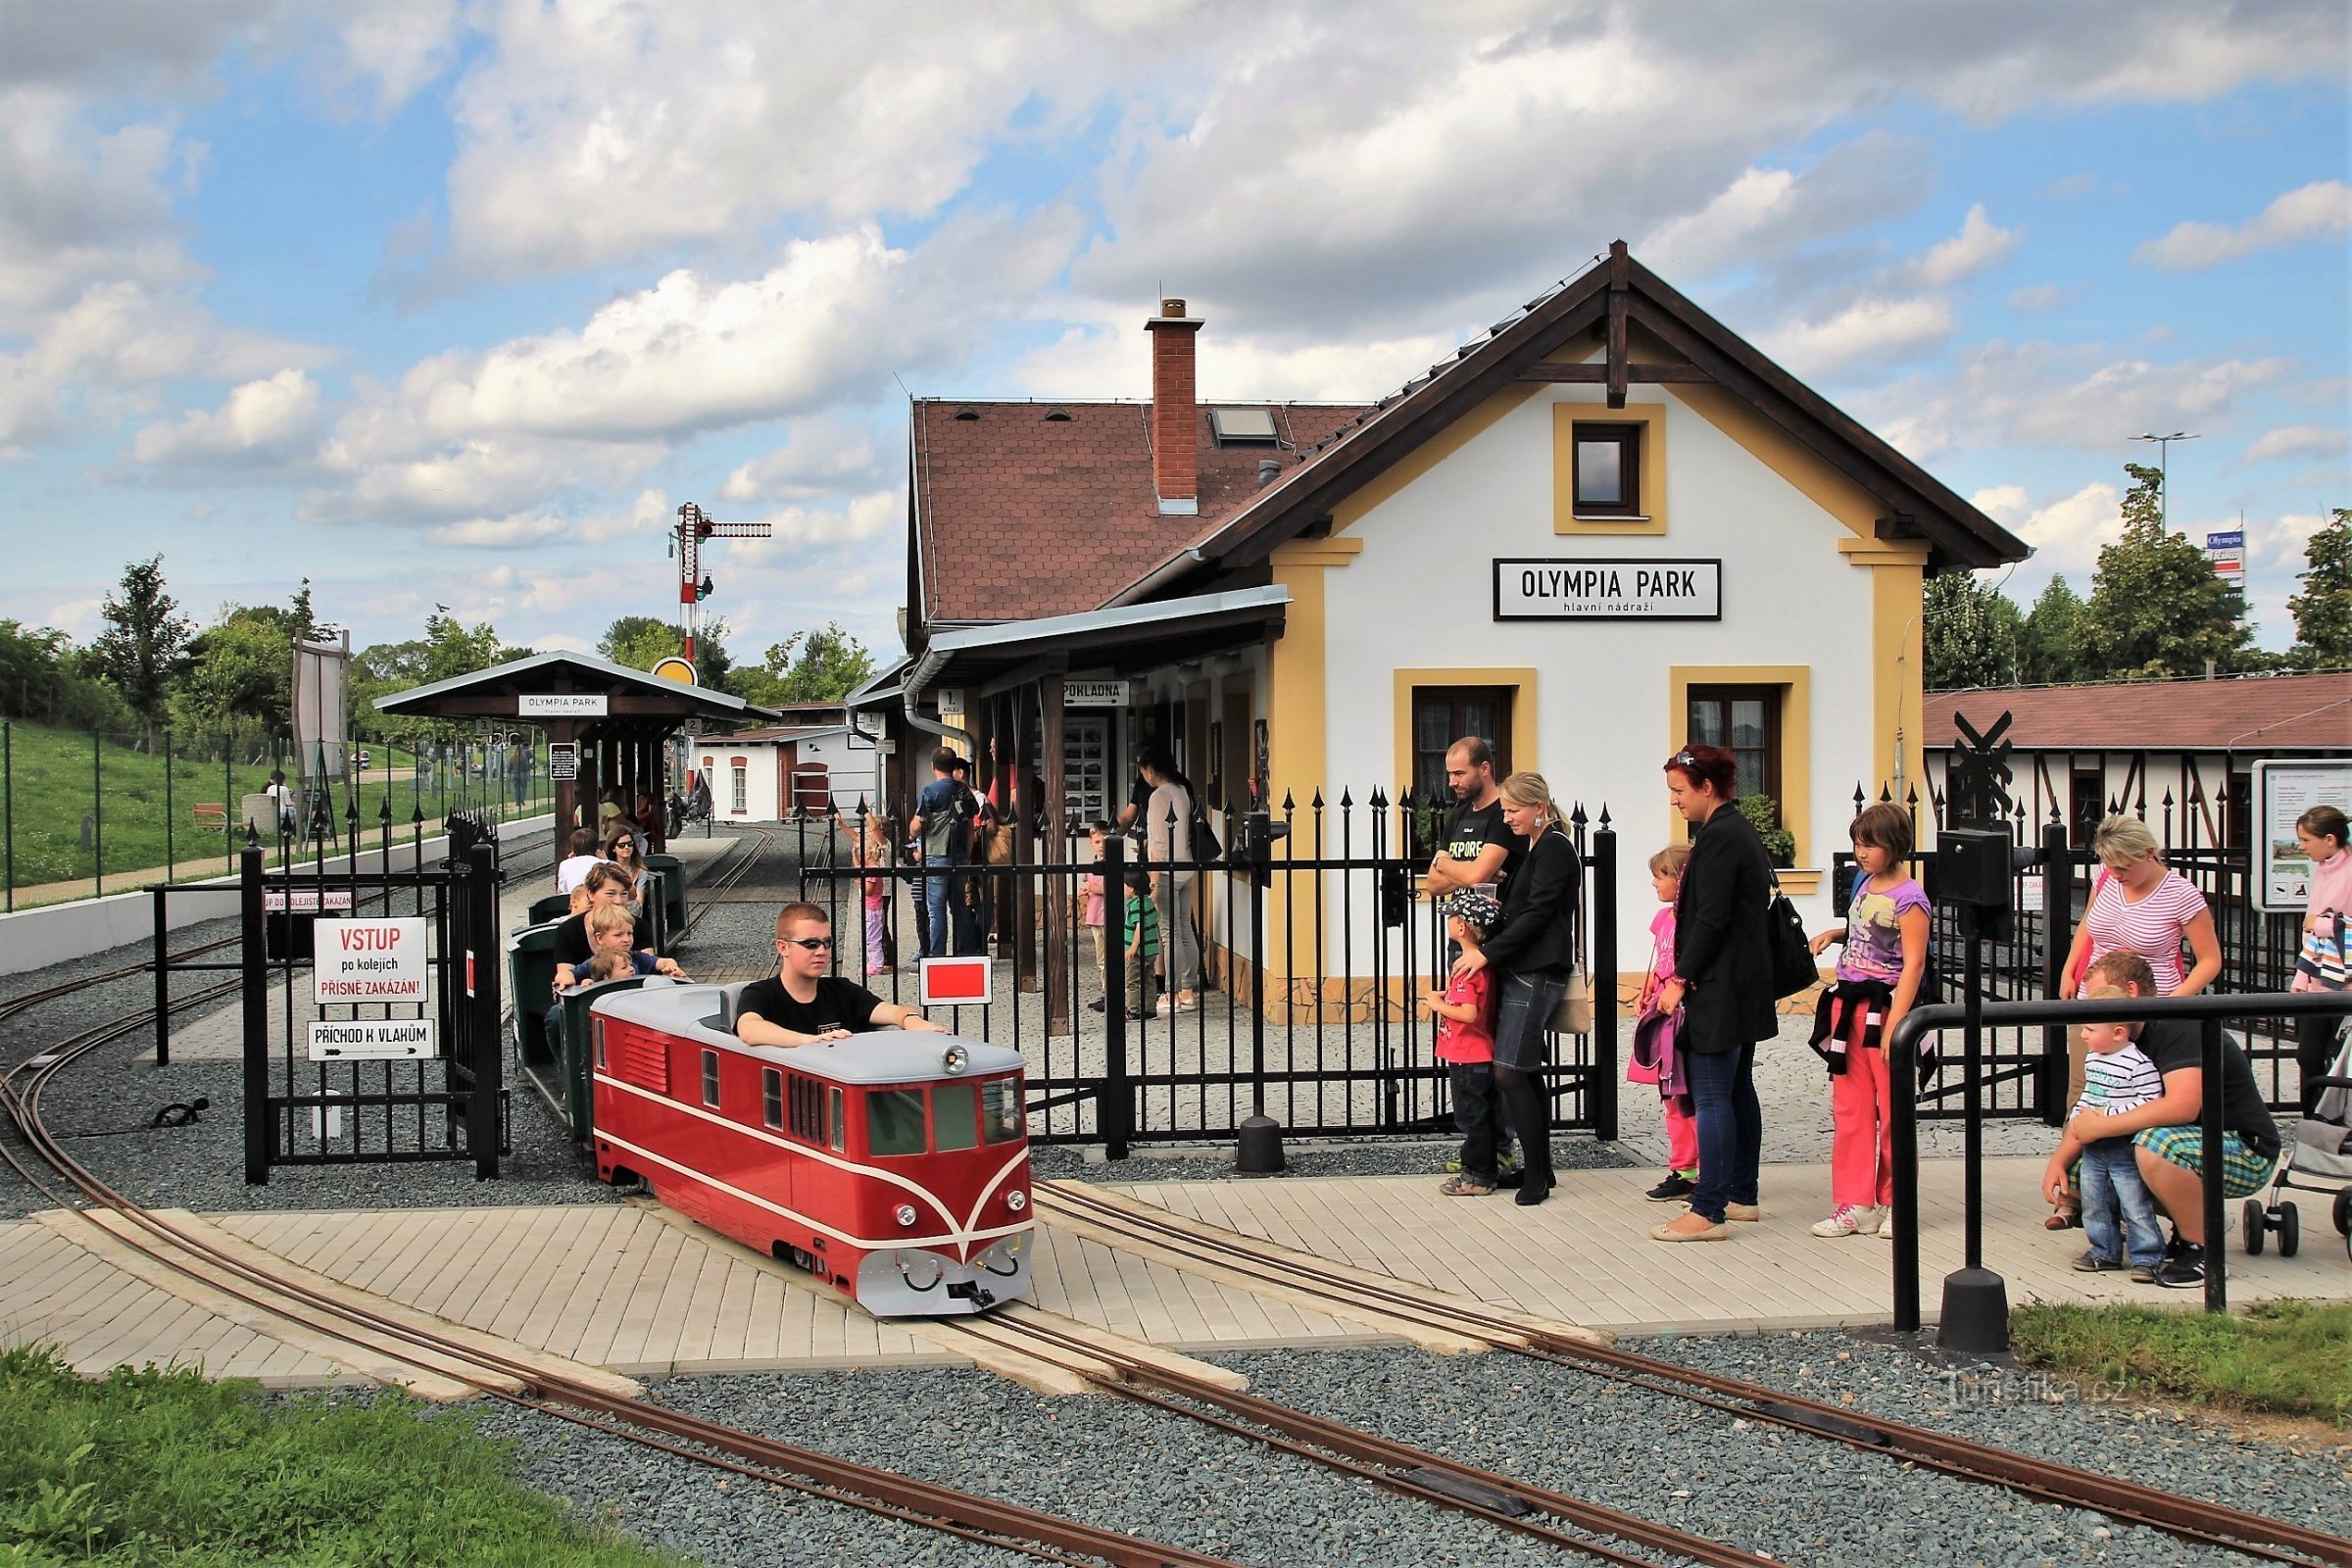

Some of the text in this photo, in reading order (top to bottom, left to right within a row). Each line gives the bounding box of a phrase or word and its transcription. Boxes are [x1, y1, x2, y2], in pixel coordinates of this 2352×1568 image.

[2208, 535, 2241, 545] Olympia
[1522, 570, 1696, 598] OLYMPIA PARK
[1564, 602, 1654, 612] hlavní nádraží
[529, 698, 598, 707] OLYMPIA PARK
[947, 691, 956, 706] 1.
[274, 898, 284, 906] DO
[340, 928, 401, 951] VSTUP
[341, 957, 398, 974] po kolejích
[321, 978, 420, 996] PŘÍSNĚ ZAKÁZÁN!
[316, 1023, 427, 1044] PŘÍCHOD K VLAKŮM
